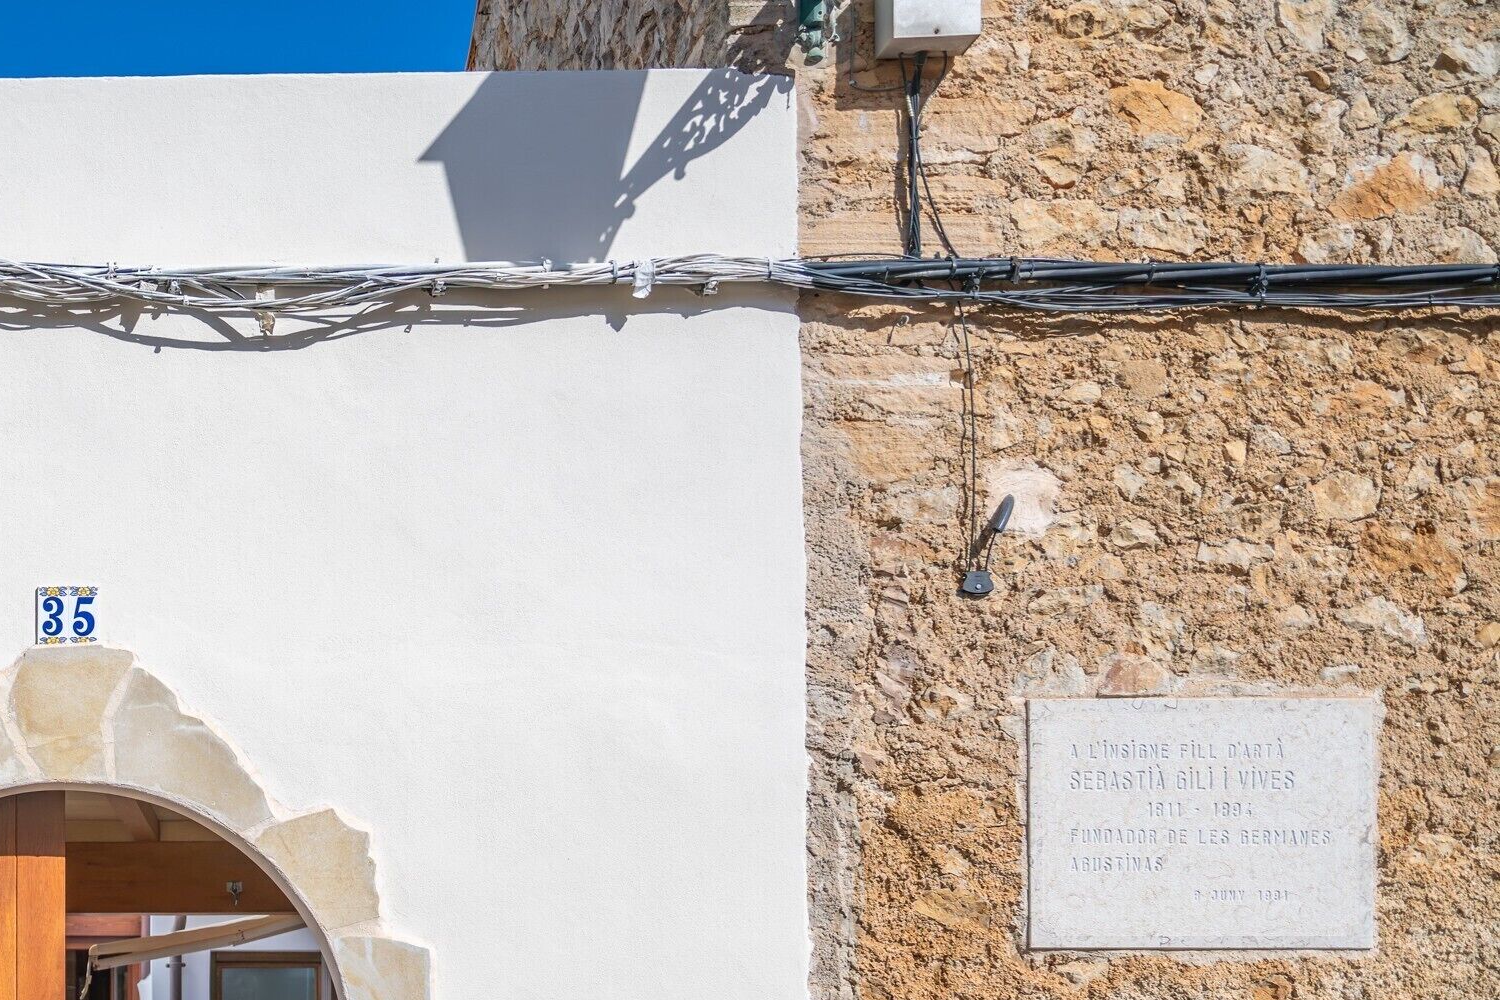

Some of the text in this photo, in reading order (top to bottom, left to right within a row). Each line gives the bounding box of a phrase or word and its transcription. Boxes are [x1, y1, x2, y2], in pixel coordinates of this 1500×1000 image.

[42, 596, 95, 636] 35
[1070, 743, 1079, 760] A
[1179, 739, 1218, 760] FILL
[1227, 737, 1284, 760] D'ARTÀ
[1069, 763, 1166, 791] SEBASTIÀ
[1176, 766, 1214, 791] GILI
[1237, 766, 1295, 791] VIVES
[1069, 828, 1332, 846] FUNDADOR DE LES GERMANES
[1069, 852, 1164, 872] AGUSTINAS
[1210, 889, 1246, 902] JUNY
